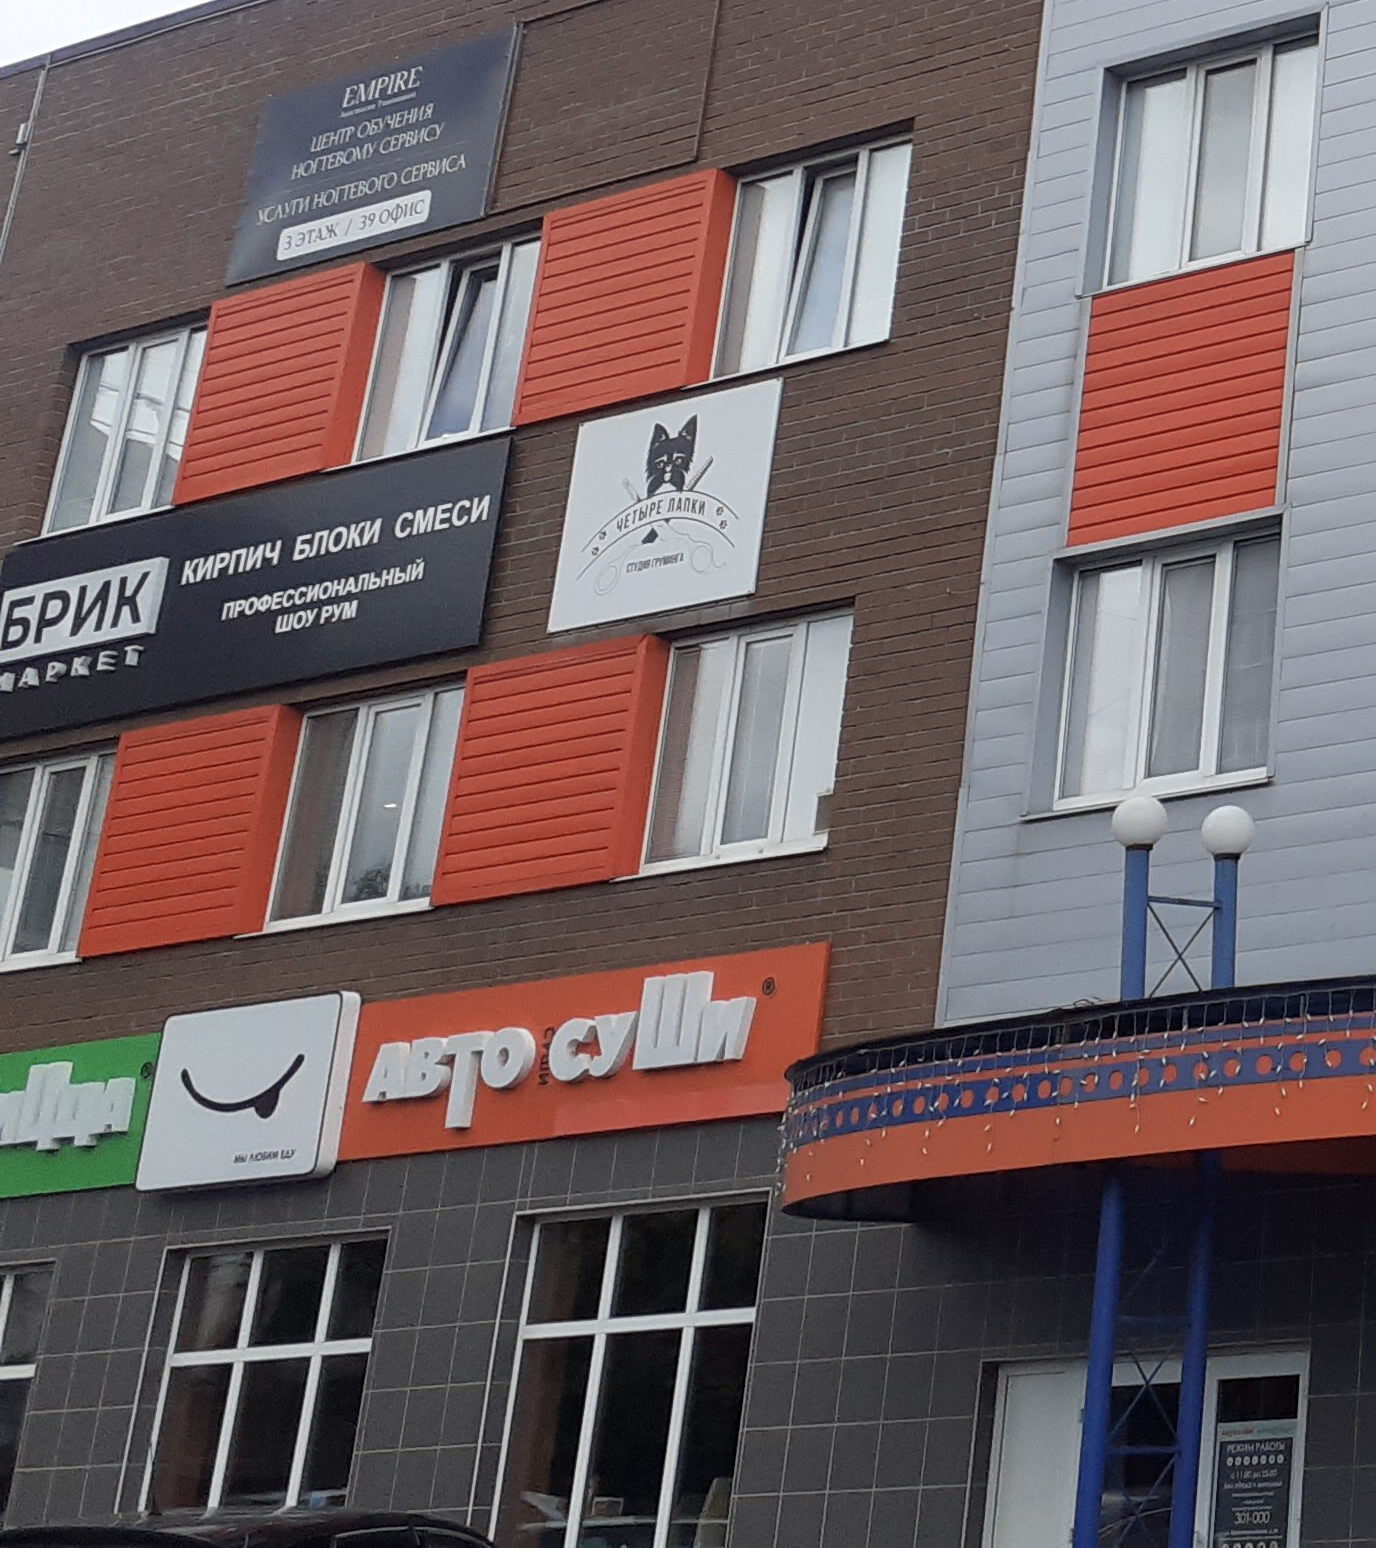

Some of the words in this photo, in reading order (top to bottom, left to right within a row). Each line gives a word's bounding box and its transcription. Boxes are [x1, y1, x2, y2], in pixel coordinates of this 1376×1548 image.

[341, 66, 423, 108] EMPIRE
[291, 143, 376, 180] НОГТЕВОМУ
[379, 122, 445, 155] СЕРВИСУ
[310, 127, 354, 152] ЦЕНТР
[357, 103, 434, 139] ОБУЧЕНИЯ
[257, 196, 310, 225] УСЛУГИ
[312, 172, 397, 209] НОГТЕВОГО
[401, 153, 466, 185] СЕРВИСА
[295, 222, 338, 246] ЭТАЖ
[359, 213, 376, 230] 39
[378, 200, 425, 224] ОФИС
[180, 539, 282, 586] КИРПИЧ
[292, 517, 382, 561] БЛОКИ
[393, 494, 491, 539] СМЕСИ
[616, 499, 664, 532] ЧЕТЫРЕ
[667, 497, 706, 516] ЛАПКИ
[2, 569, 151, 650] БРИК
[220, 558, 425, 621] ПРОФЕССИОНАЛЬНЫЙ
[274, 608, 317, 634] ШОУ
[319, 600, 358, 626] РУМ
